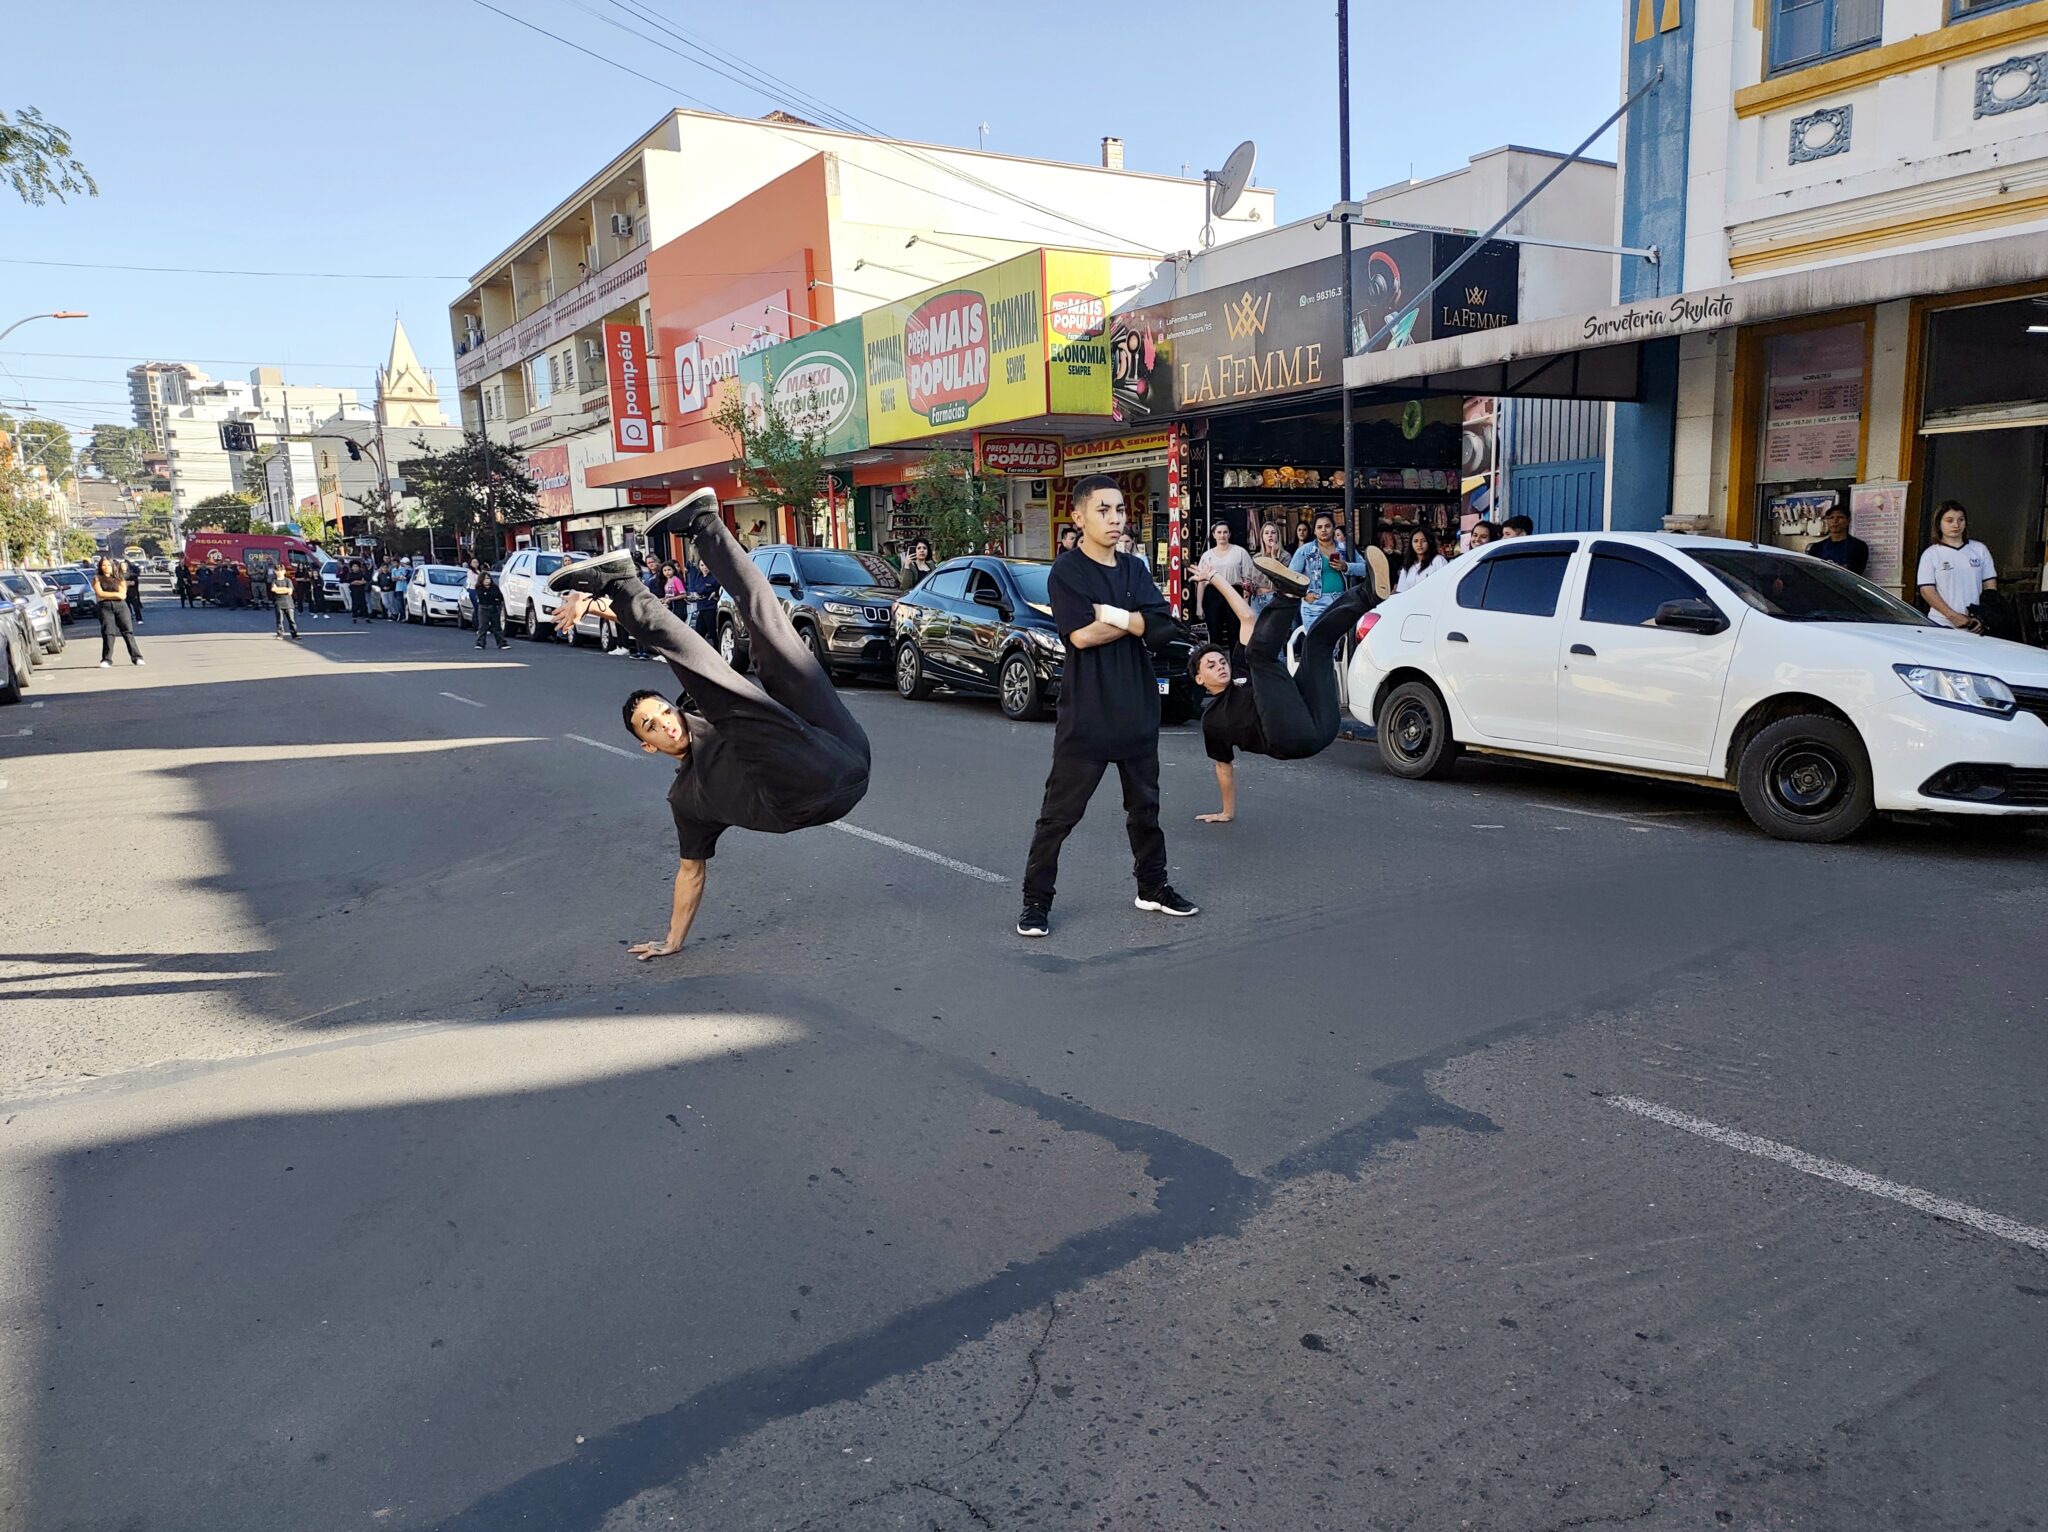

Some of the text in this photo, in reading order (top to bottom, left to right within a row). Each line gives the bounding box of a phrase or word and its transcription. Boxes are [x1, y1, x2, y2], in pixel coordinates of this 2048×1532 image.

[1068, 298, 1103, 315] MAIS
[1583, 293, 1735, 339] Sorveteria Skylato
[907, 302, 983, 358] PREÇO MAIS
[990, 289, 1039, 354] ECONOMIA
[1053, 313, 1103, 331] POPULAR
[867, 333, 904, 386] ECONOMIA
[1050, 343, 1107, 365] ECONOMIA
[617, 331, 642, 415] pompéia
[786, 366, 831, 393] MAXXI
[911, 346, 986, 400] POPULAR
[1006, 354, 1026, 385] SEMPRE
[1068, 364, 1091, 376] SEMPRE
[931, 403, 966, 424] Farmácias
[986, 442, 1056, 454] PREÇO MAIS
[1063, 433, 1168, 457] NOMIA SEMPR
[987, 454, 1057, 466] POPULAR
[1168, 433, 1181, 619] FARMÁCIA
